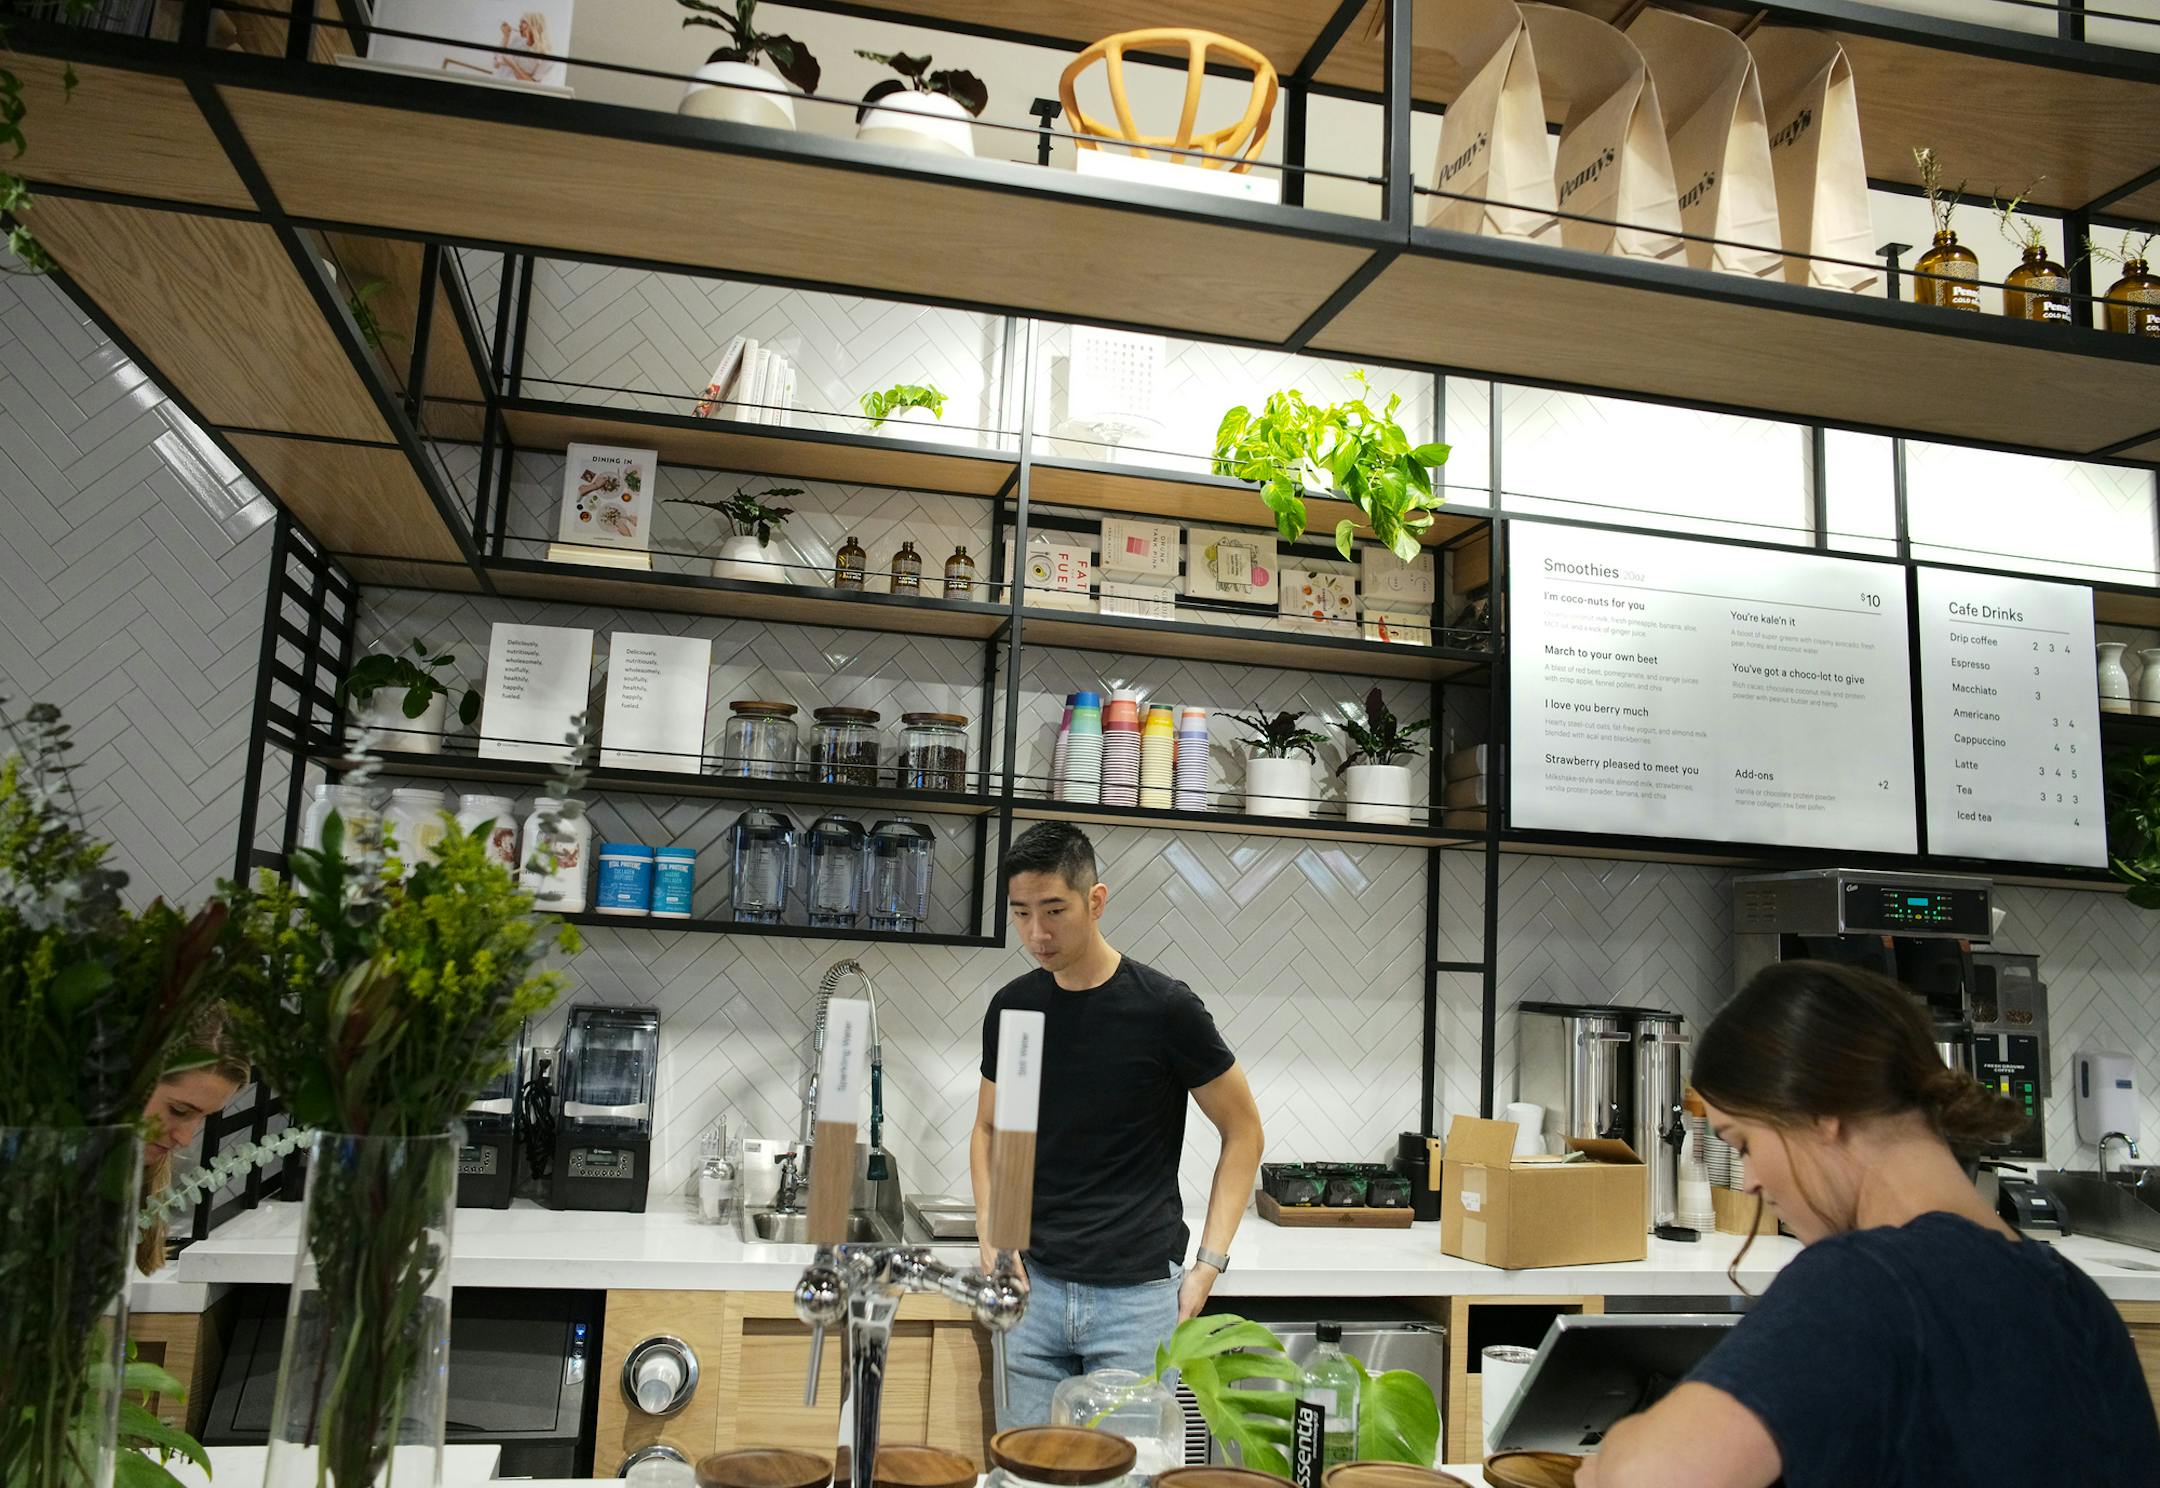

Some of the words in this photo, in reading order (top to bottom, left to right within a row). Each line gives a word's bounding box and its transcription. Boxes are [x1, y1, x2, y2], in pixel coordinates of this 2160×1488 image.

[1769, 110, 1811, 152] nny's
[1438, 132, 1487, 189] Penny's
[1559, 148, 1614, 206] Penny's
[1679, 171, 1714, 211] nny's
[1077, 561, 1088, 589] FAT
[1544, 558, 1619, 578] Smoothies
[1544, 592, 1558, 600] I'm
[1561, 594, 1609, 606] coco-nuts
[1612, 598, 1625, 608] for
[1628, 601, 1645, 611] you
[1861, 593, 1880, 608] $10
[1730, 610, 1758, 623] You're
[1761, 614, 1786, 625] kale'n
[1790, 617, 1795, 626] it
[1949, 602, 1978, 617] Cafe
[1983, 605, 2023, 622] Drinks
[1950, 632, 1968, 644] Drip
[1971, 636, 1998, 646] coffee
[2033, 642, 2038, 651] 2
[2049, 644, 2055, 653] 3
[2065, 645, 2070, 654] 4
[1545, 645, 1575, 656] March
[1578, 648, 1588, 658] to
[1590, 651, 1612, 660] your
[1615, 653, 1635, 662] own
[1637, 654, 1658, 664] beet
[1732, 663, 1761, 675] You've
[1764, 668, 1778, 678] got
[1790, 668, 1832, 681] choco-lot
[1834, 674, 1843, 683] to
[1846, 674, 1864, 685] give
[1952, 657, 1990, 670] Espresso
[2034, 666, 2040, 676] 3
[1952, 683, 1997, 696] Macchiato
[2035, 691, 2041, 701] 3
[1545, 699, 1548, 708] I
[1551, 699, 1571, 710] love
[1574, 703, 1591, 712] you
[1594, 702, 1620, 716] berry
[1623, 706, 1649, 717] much
[1954, 708, 2000, 721] Americano
[2053, 718, 2059, 727] 3
[2069, 720, 2074, 728] 4
[1954, 733, 2006, 747] Cappuccino
[2054, 743, 2060, 752] 4
[2070, 744, 2076, 754] 5
[1546, 753, 1599, 769] Strawberry
[1603, 758, 1640, 770] pleased
[1643, 762, 1652, 771] to
[1655, 764, 1678, 773] meet
[1682, 766, 1699, 776] you
[1955, 759, 1978, 770] Latte
[2039, 767, 2045, 776] 3
[2056, 768, 2061, 777] 4
[2072, 770, 2078, 779] 5
[1735, 769, 1774, 781] Add-ons
[1878, 780, 1888, 790] +2
[1956, 784, 1972, 795] Tea
[2040, 792, 2046, 801] 3
[2057, 794, 2063, 803] 3
[2073, 795, 2078, 804] 3
[1957, 810, 1976, 821] Iced
[1978, 812, 1992, 822] tea
[2074, 818, 2080, 827] 4
[1297, 1407, 1313, 1488] ssentia
